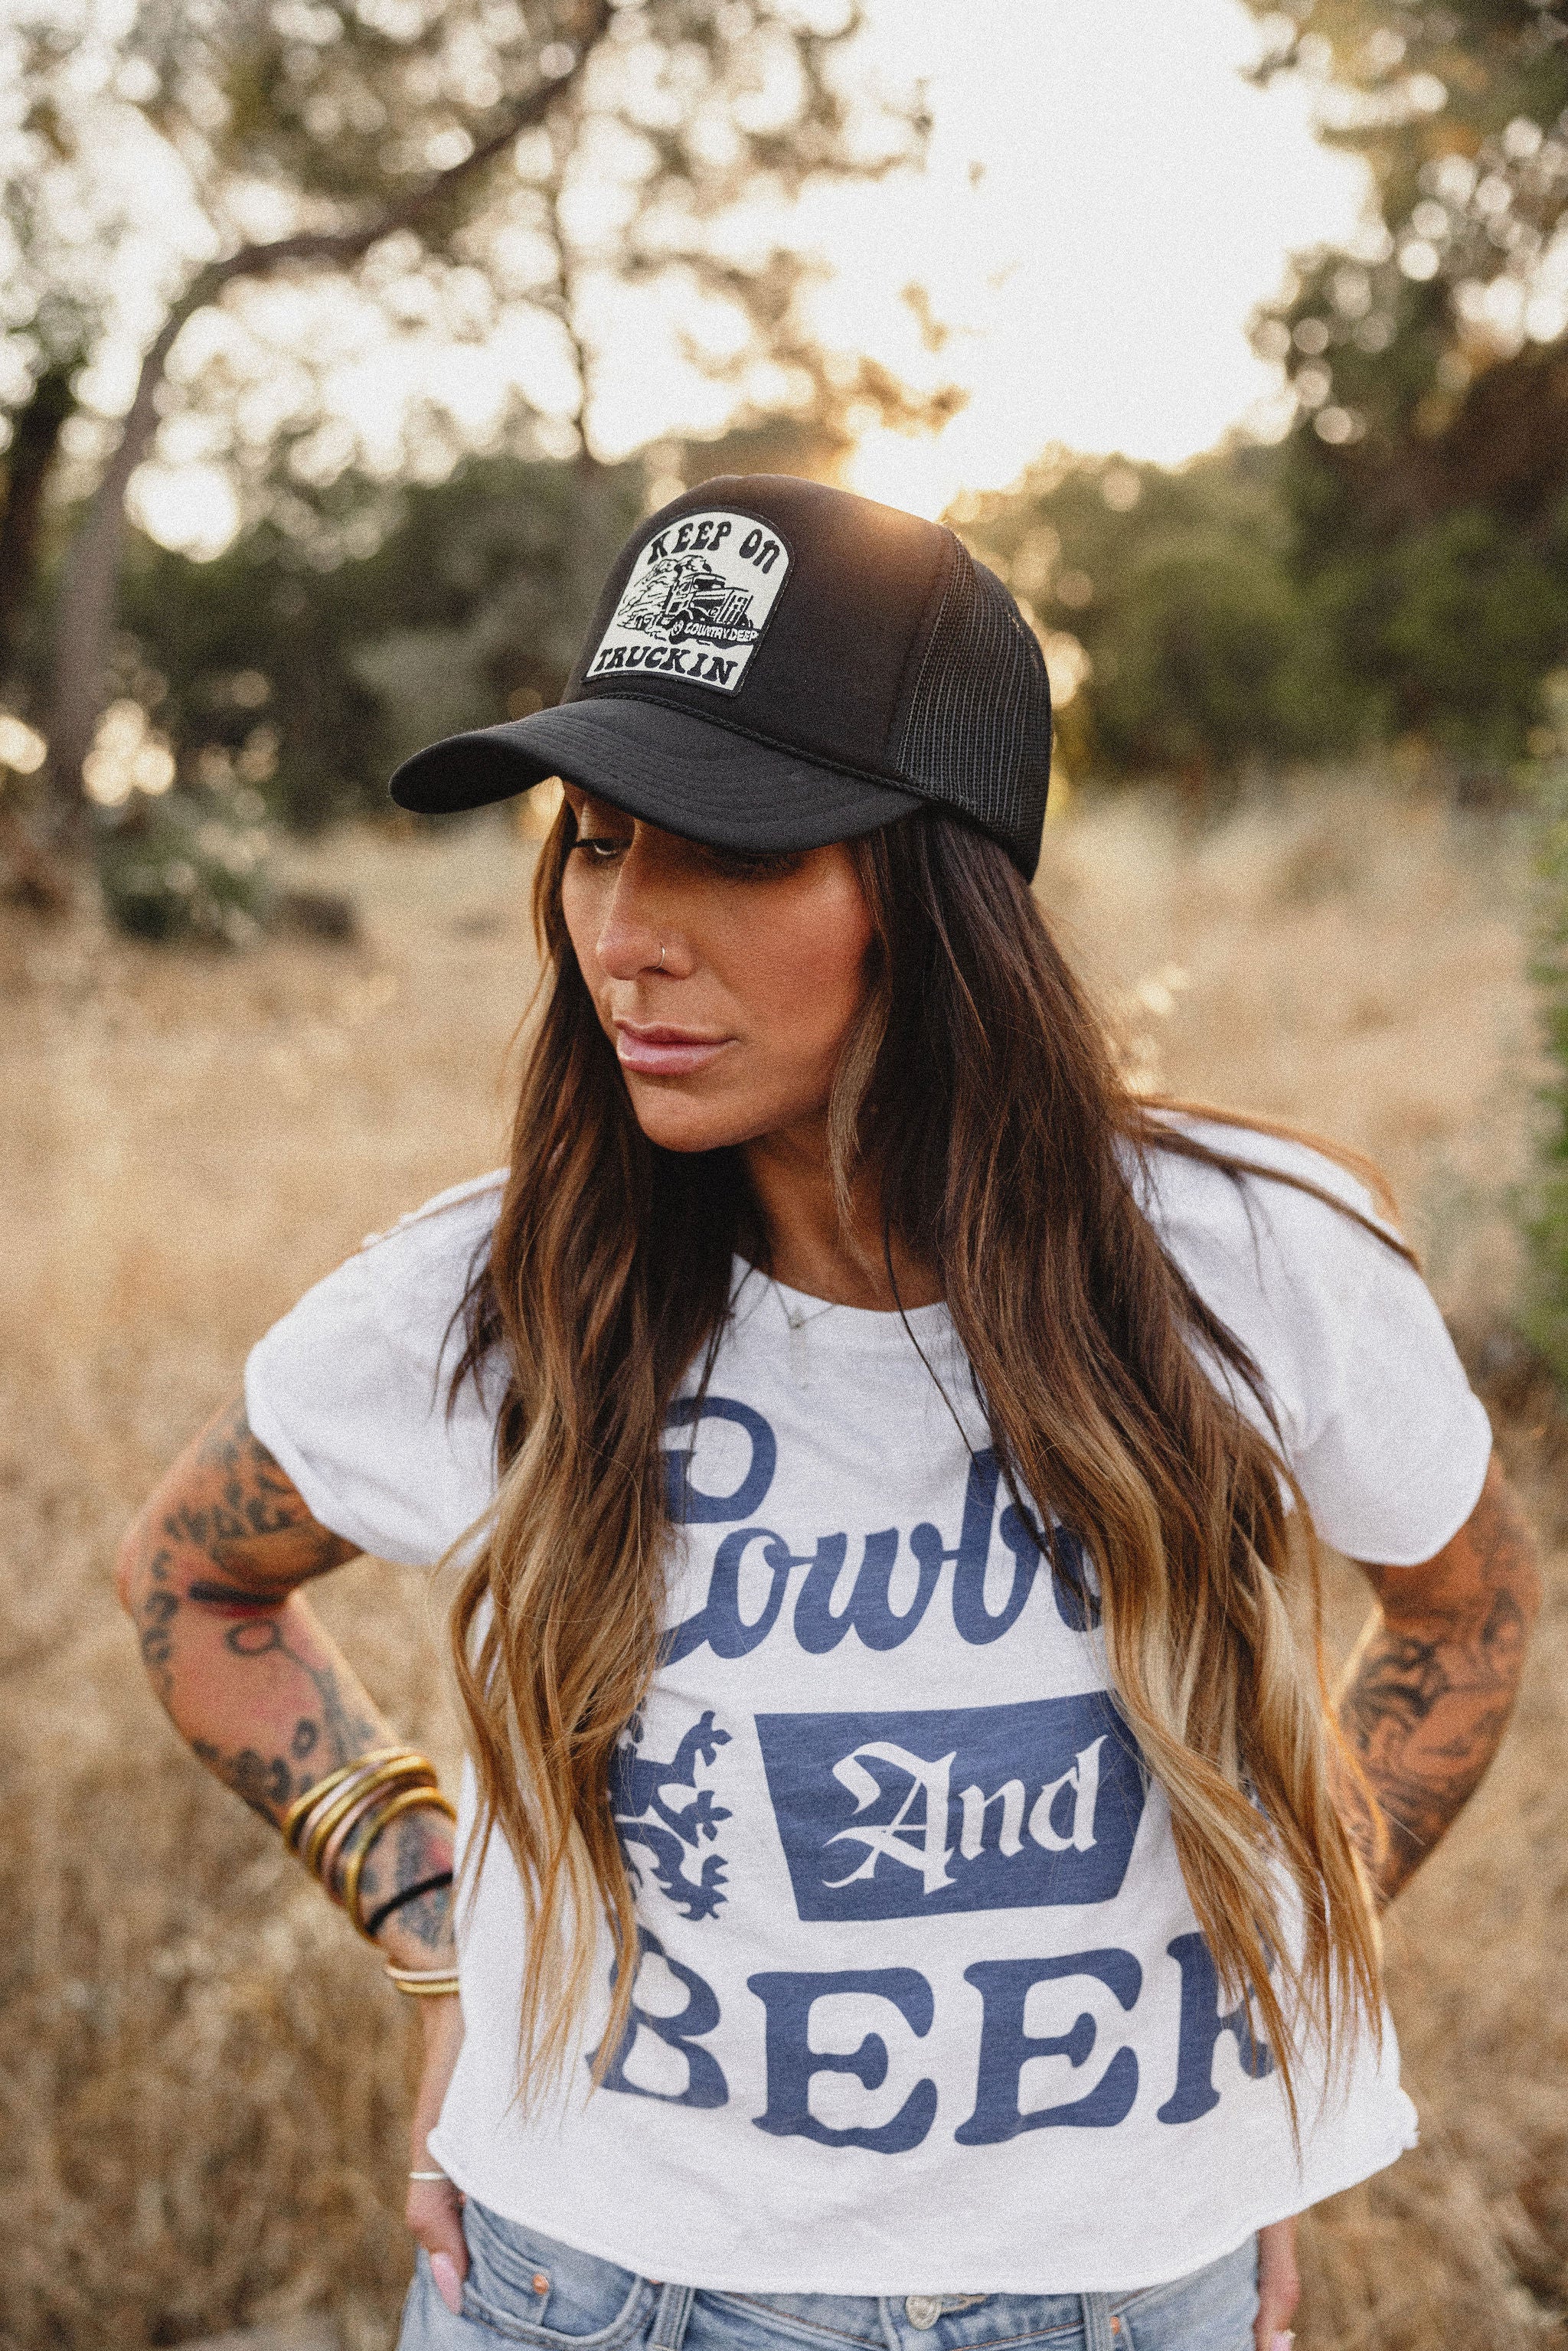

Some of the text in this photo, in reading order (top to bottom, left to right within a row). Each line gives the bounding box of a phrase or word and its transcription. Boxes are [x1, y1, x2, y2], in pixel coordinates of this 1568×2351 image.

[647, 521, 731, 564] KEEP
[728, 628, 760, 642] DEEP
[593, 646, 738, 684] TRUCKIN
[822, 1734, 1109, 1895] And
